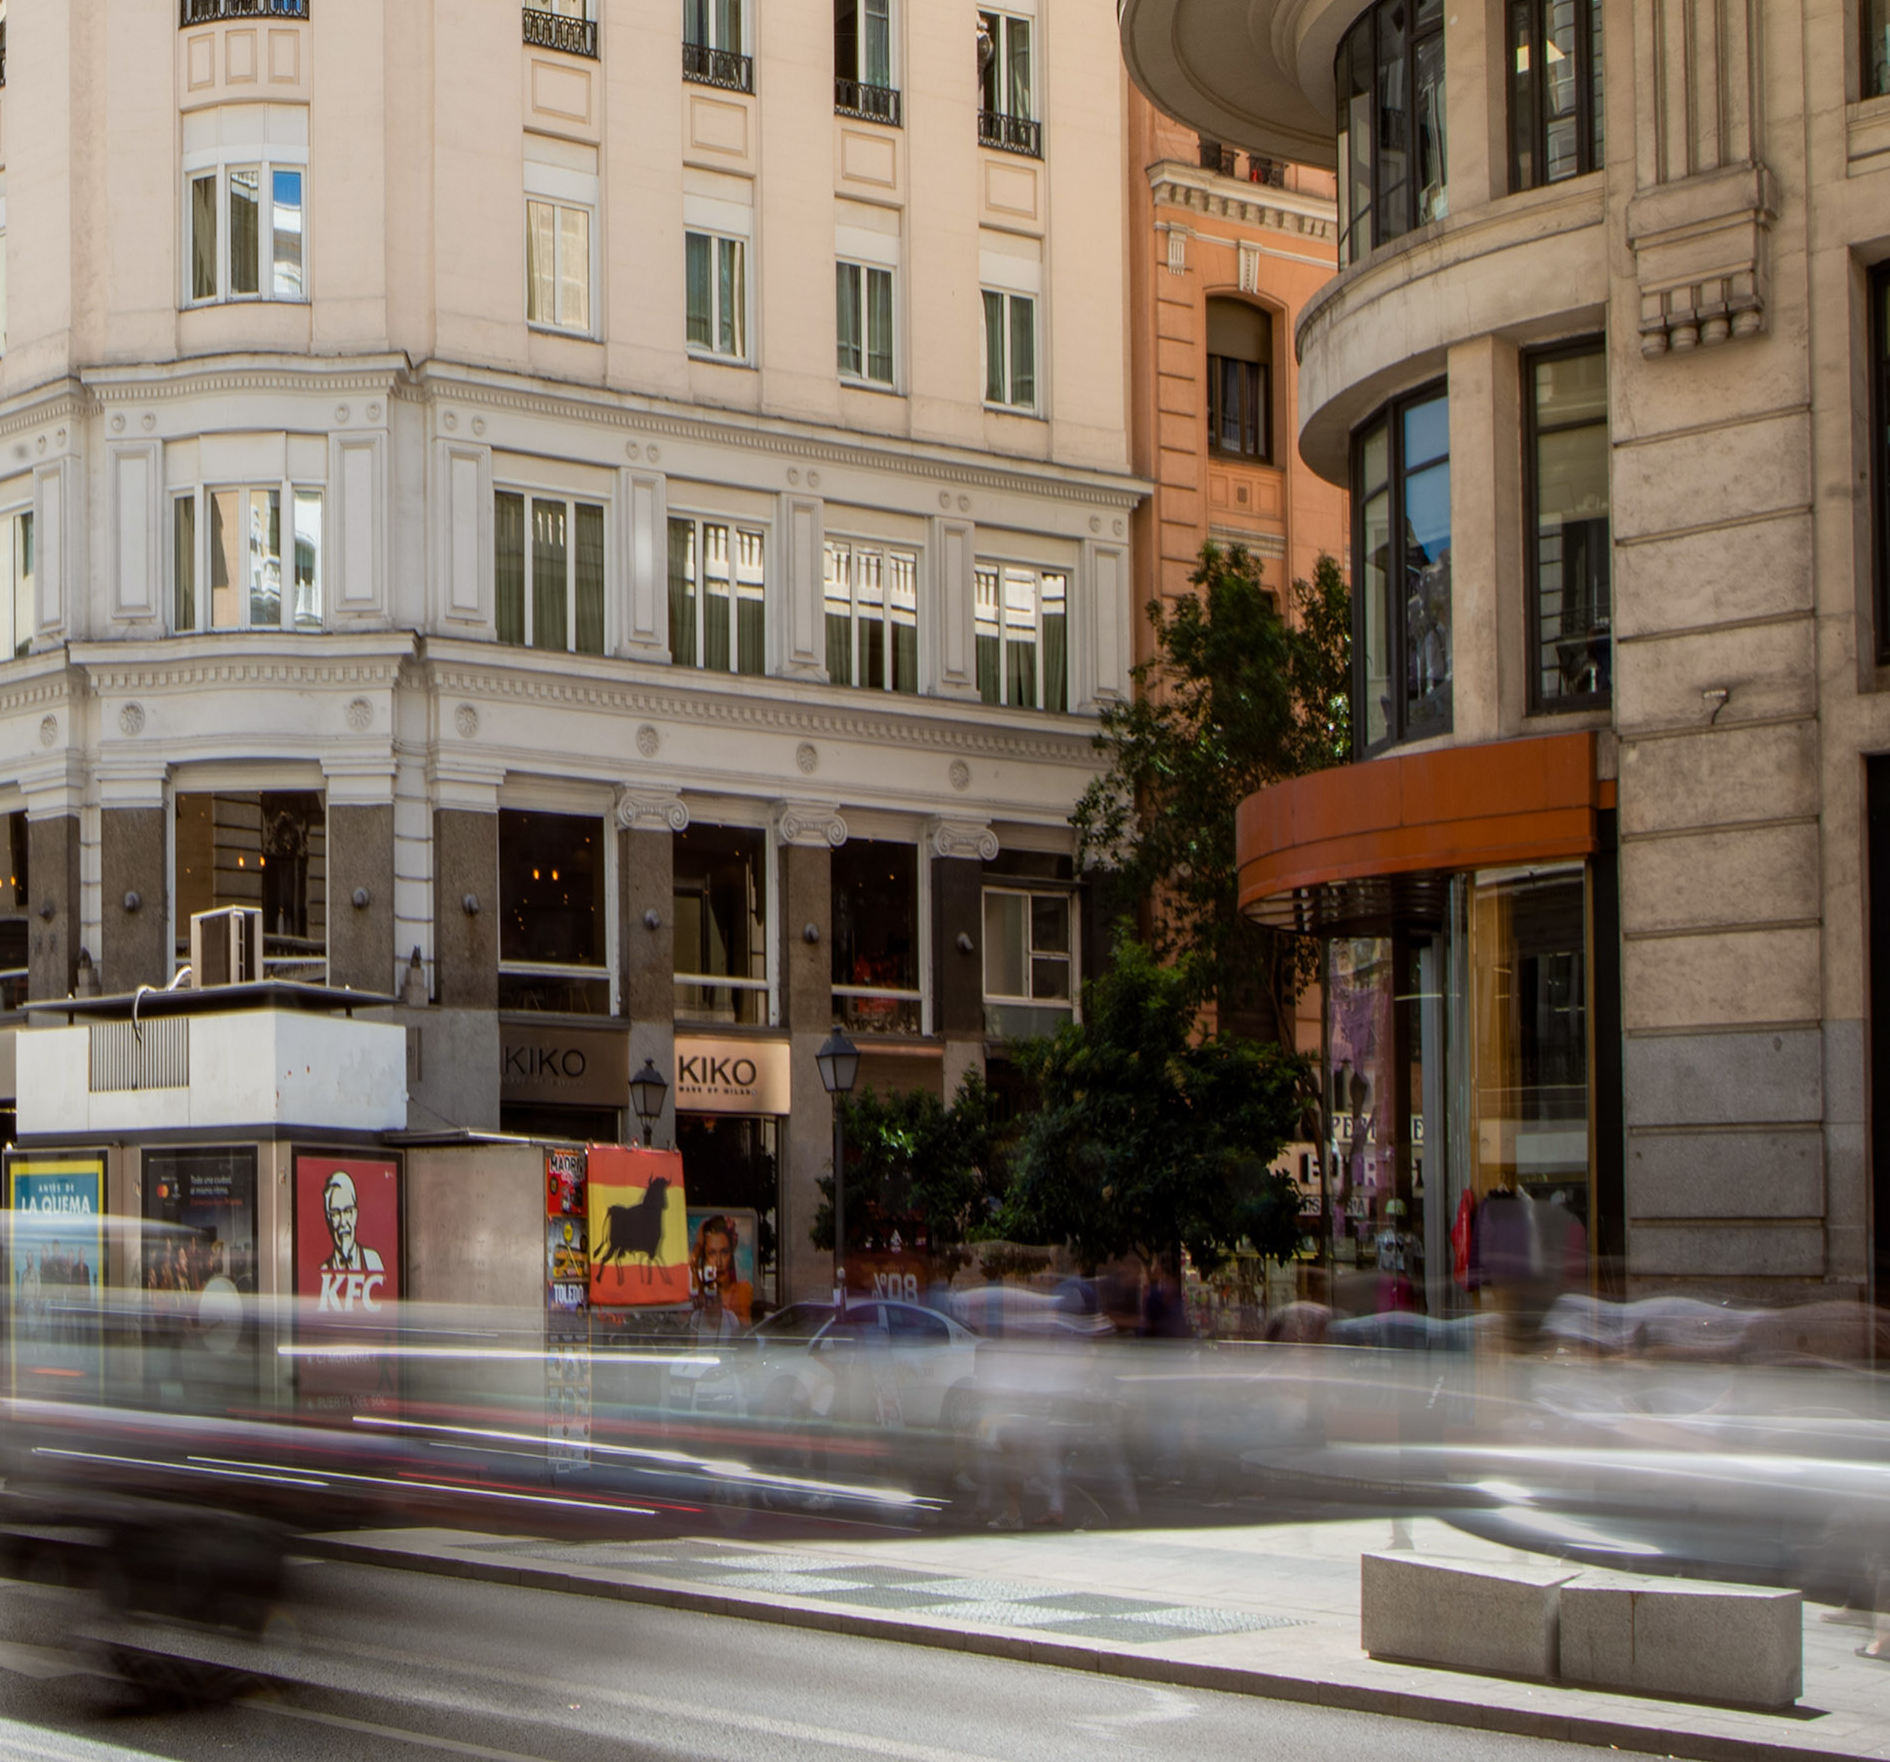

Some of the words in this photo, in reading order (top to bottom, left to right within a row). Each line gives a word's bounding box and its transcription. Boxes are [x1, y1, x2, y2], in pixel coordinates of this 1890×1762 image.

[502, 1046, 587, 1078] KIKO
[677, 1054, 757, 1086] KIKO
[21, 1195, 38, 1215] LA
[41, 1194, 91, 1217] QUEMA
[318, 1272, 385, 1313] KFC
